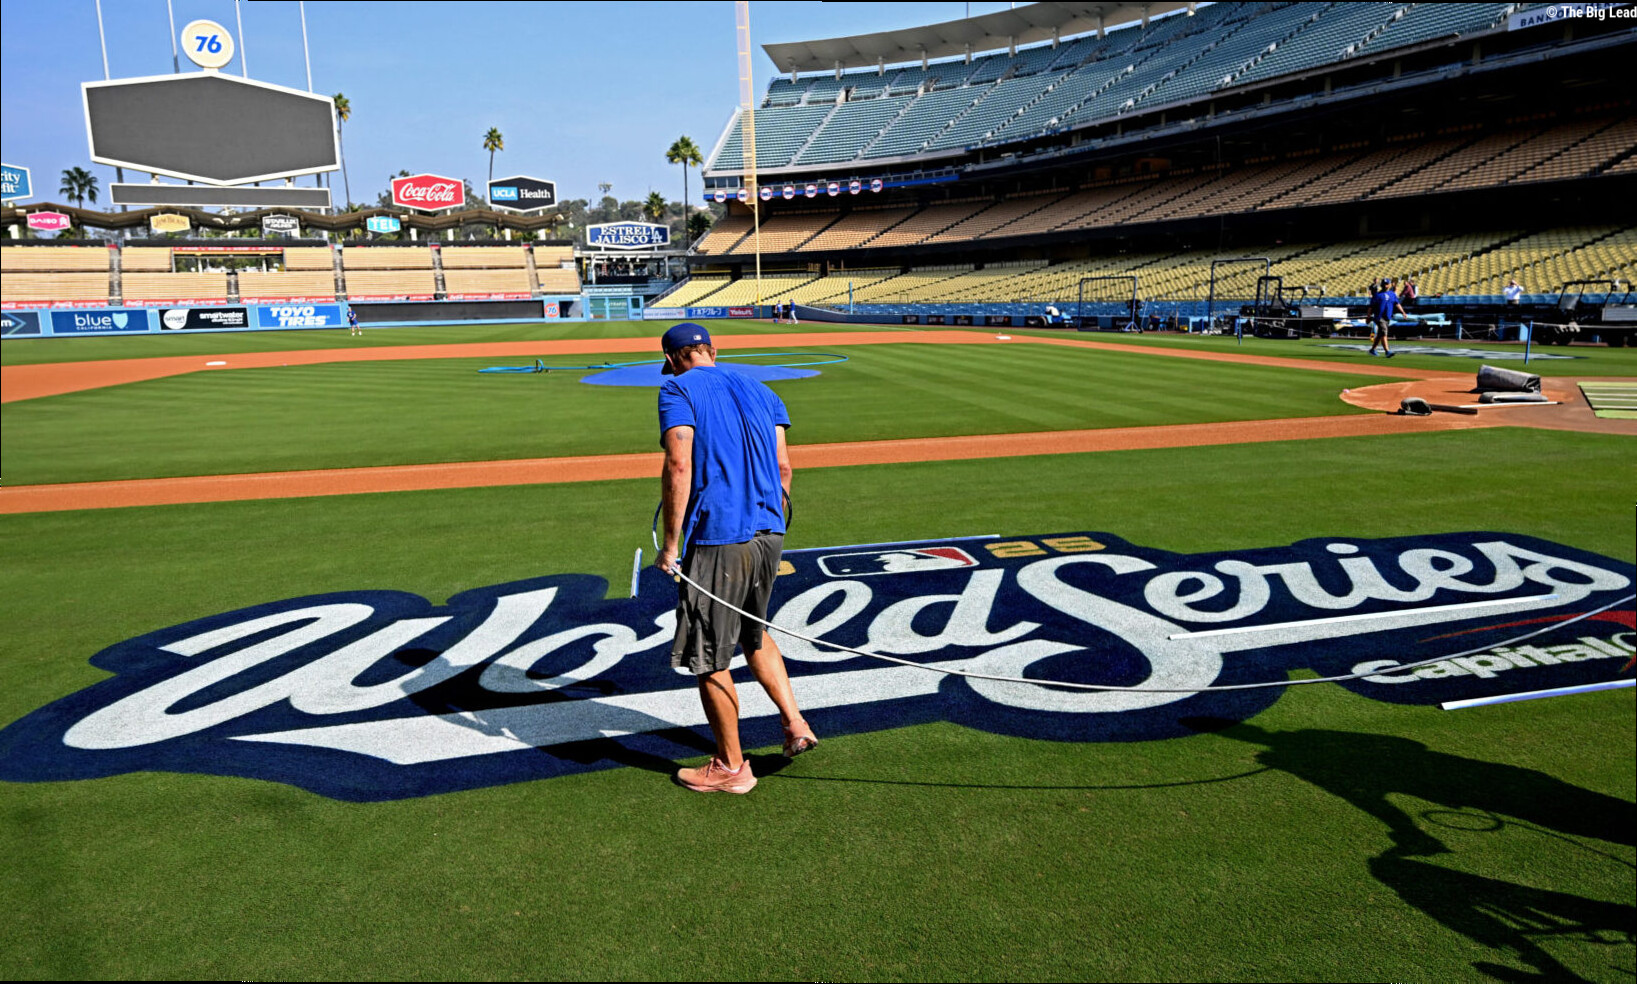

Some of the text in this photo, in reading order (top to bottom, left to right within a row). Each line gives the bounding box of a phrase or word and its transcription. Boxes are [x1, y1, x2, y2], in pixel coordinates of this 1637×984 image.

[194, 34, 222, 54] 76
[399, 182, 457, 202] Coca-Cola
[492, 188, 551, 199] UCLA Health
[595, 235, 649, 244] JALISCO
[270, 306, 315, 317] TOYO
[74, 313, 112, 327] blue
[278, 315, 327, 327] TIRES
[984, 536, 1107, 559] 25
[63, 540, 1634, 751] Wold Series
